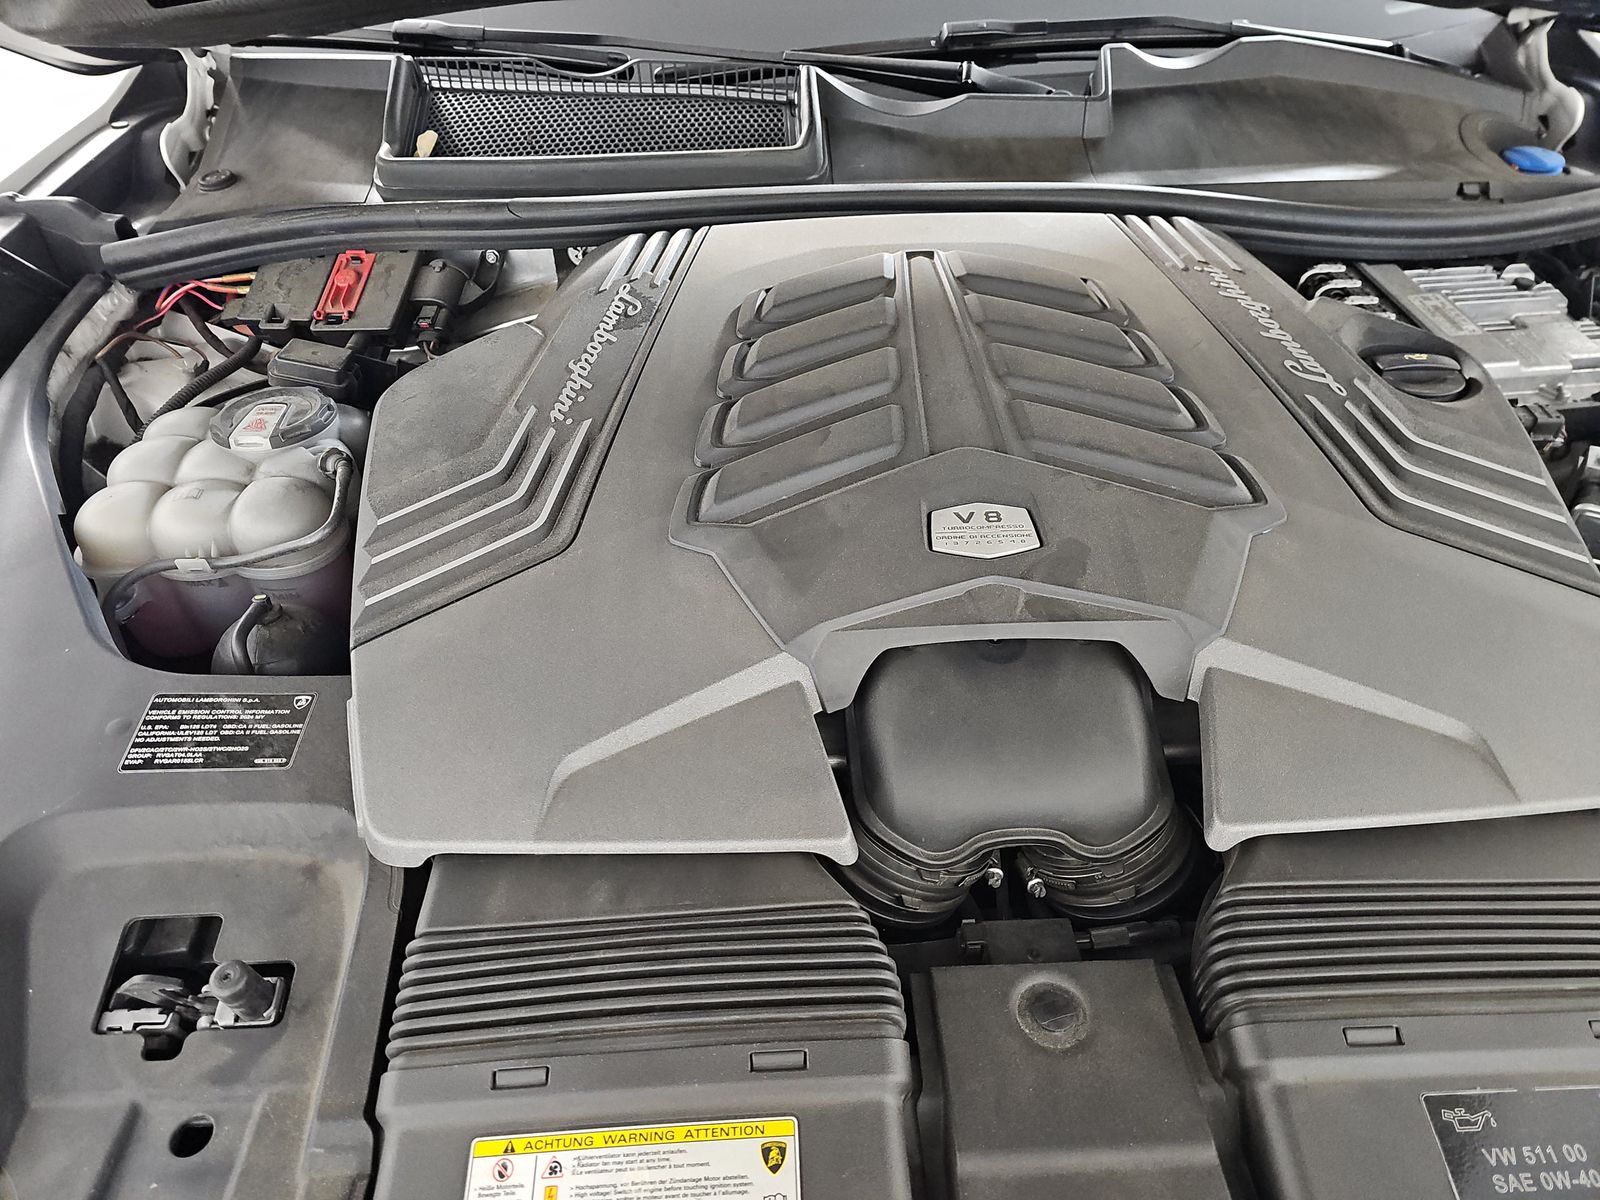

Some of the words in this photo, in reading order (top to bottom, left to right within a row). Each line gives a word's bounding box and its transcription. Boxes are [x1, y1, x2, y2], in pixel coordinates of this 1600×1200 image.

[1194, 264, 1347, 396] Lamborghini
[550, 283, 642, 425] Lamborghini
[523, 1135, 594, 1151] ACHTUNG
[603, 1130, 675, 1145] WARNING
[684, 1124, 765, 1139] ATTENTION
[1480, 1146, 1517, 1167] VW
[1522, 1145, 1558, 1165] 511
[1562, 1143, 1588, 1163] 00
[1492, 1172, 1537, 1193] SAE
[1539, 1168, 1600, 1191] 0W-40
